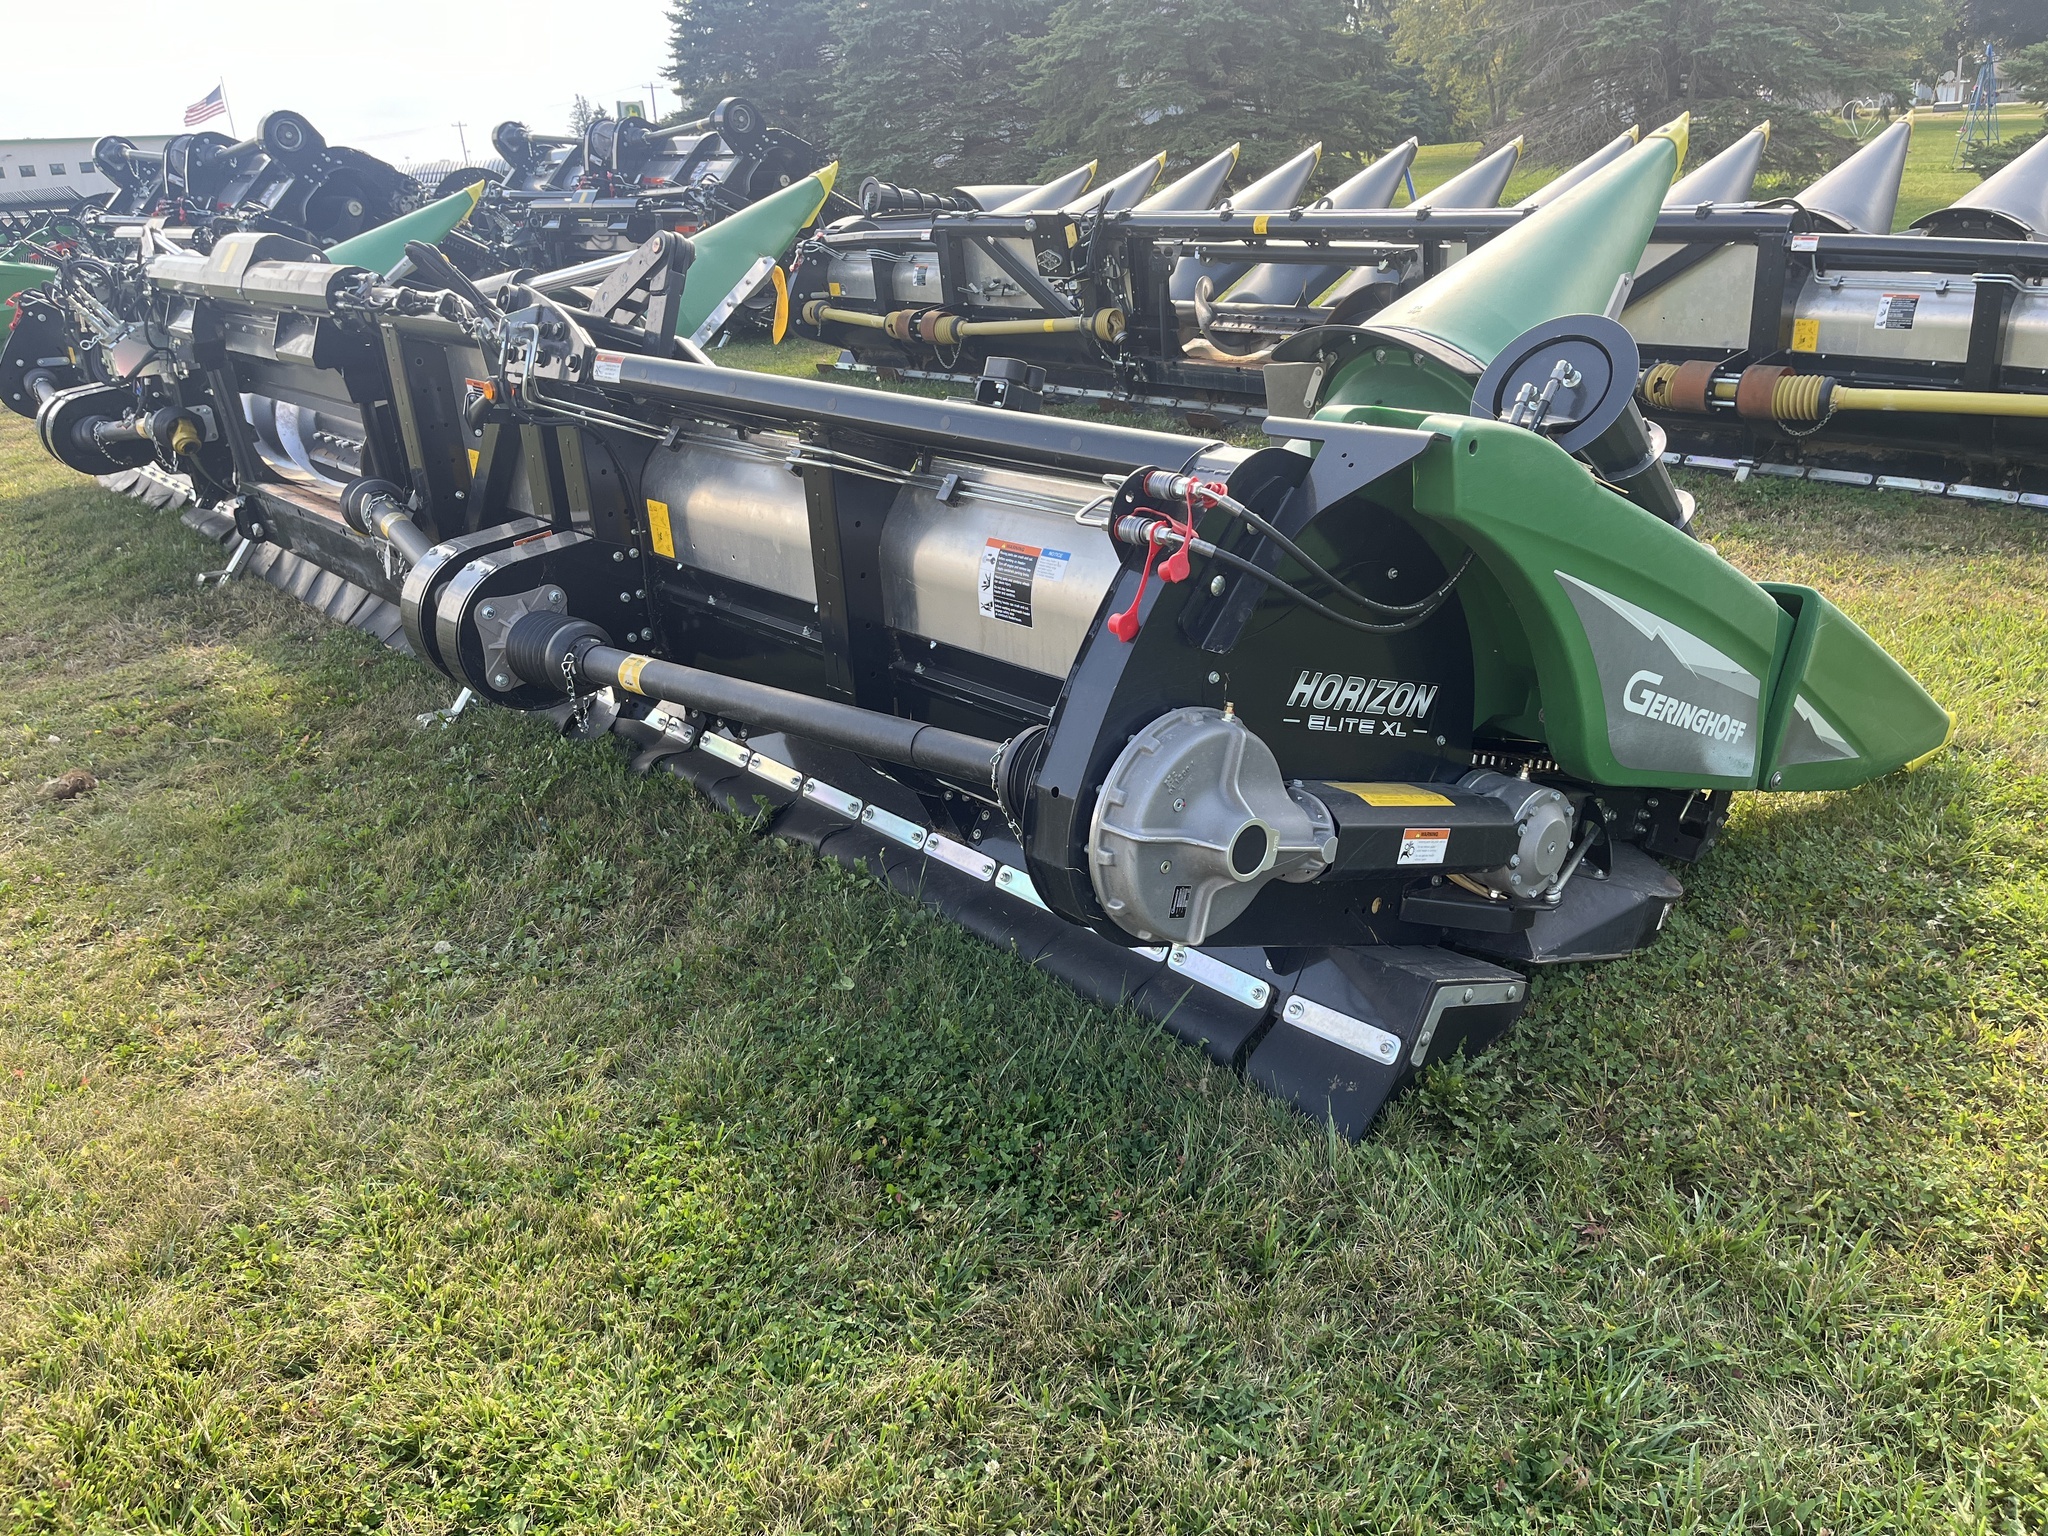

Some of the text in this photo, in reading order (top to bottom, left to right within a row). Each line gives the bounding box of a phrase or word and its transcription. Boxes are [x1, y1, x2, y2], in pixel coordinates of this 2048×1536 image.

[1286, 670, 1438, 718] HORIZON
[1623, 669, 1747, 744] GERINGHOFF
[1308, 715, 1407, 737] ELITE XL
